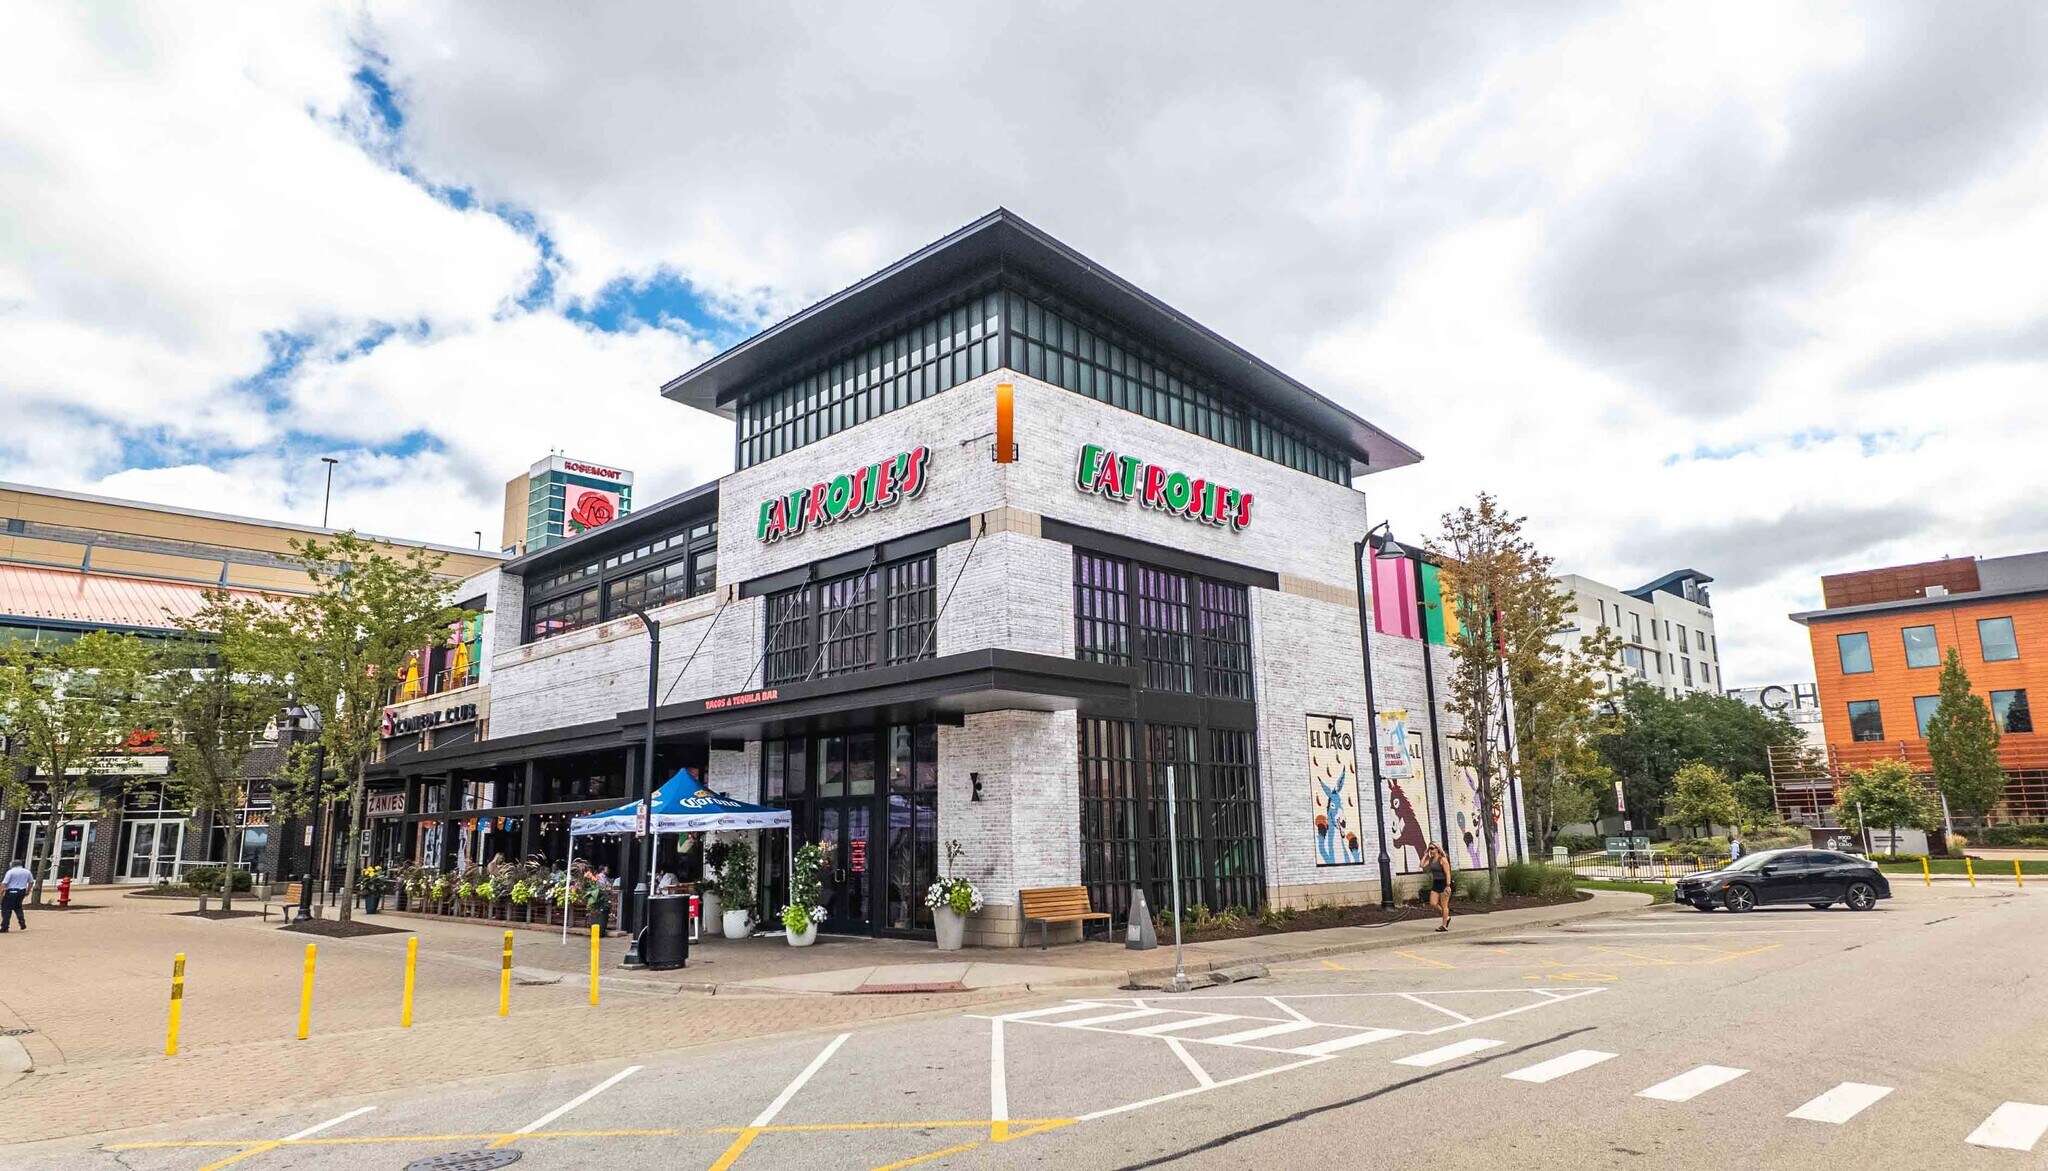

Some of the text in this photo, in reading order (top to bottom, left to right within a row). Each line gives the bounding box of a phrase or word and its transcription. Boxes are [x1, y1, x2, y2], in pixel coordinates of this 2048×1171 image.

[564, 461, 622, 480] ROSEMONT
[757, 445, 931, 544] FAT ROSIE'S
[1076, 443, 1254, 533] FAT ROSIE'S
[705, 698, 726, 710] TACOS
[732, 692, 761, 705] TEQUILA
[761, 689, 778, 701] BAR
[396, 710, 442, 734] COMEDY
[445, 703, 477, 724] CLUB
[1309, 730, 1323, 748] EL
[368, 794, 405, 813] ZANIES
[679, 796, 742, 809] Corona
